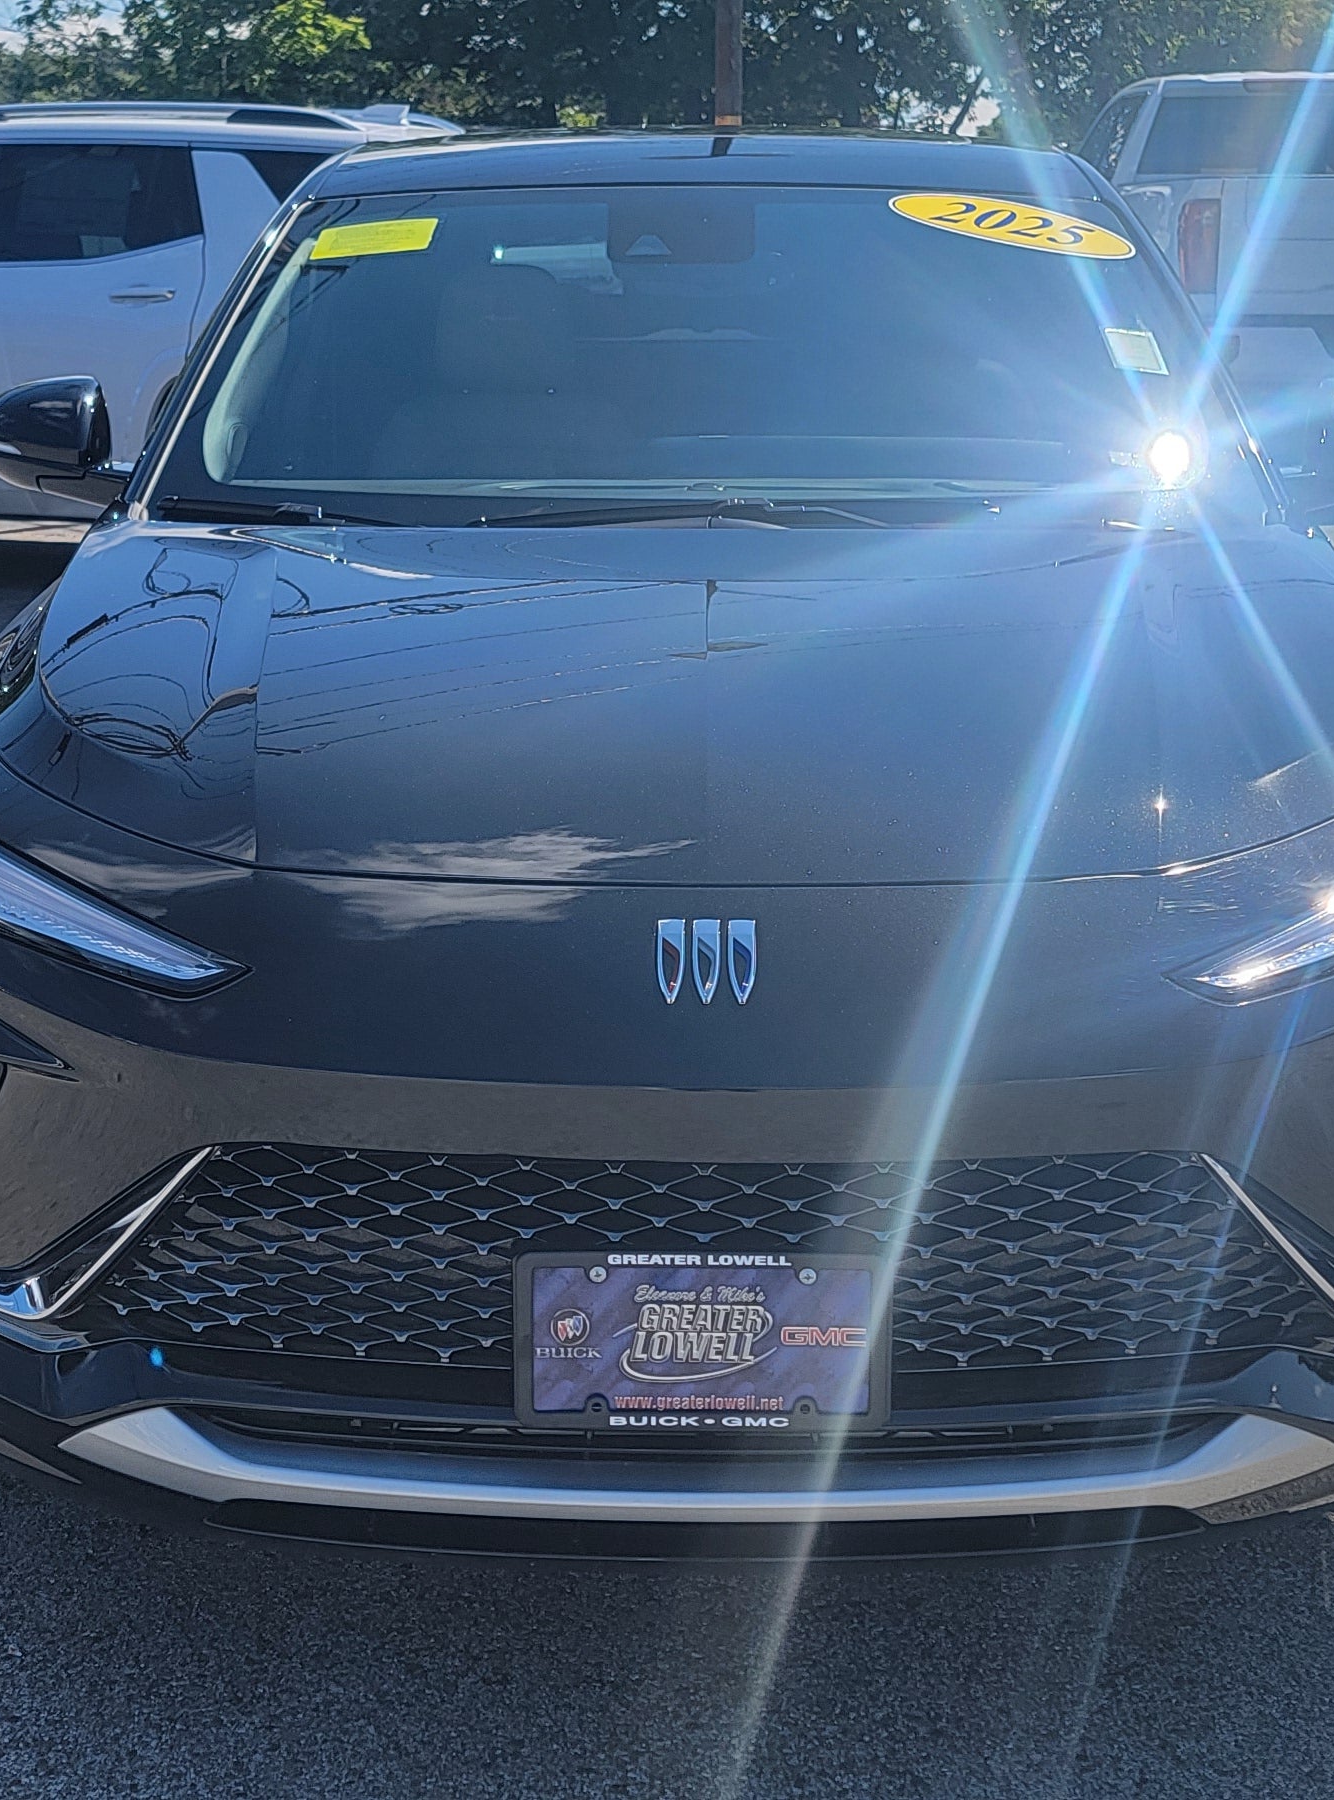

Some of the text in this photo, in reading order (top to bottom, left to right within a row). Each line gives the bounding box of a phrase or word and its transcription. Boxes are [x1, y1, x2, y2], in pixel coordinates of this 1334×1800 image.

[929, 202, 1095, 245] 2025
[607, 1254, 793, 1267] GREATER LOWELL
[717, 1285, 766, 1304] Mike's
[638, 1303, 766, 1333] GREATER
[781, 1327, 867, 1347] GMC
[534, 1346, 603, 1359] BUICK
[629, 1331, 756, 1364] LOWELL
[614, 1395, 785, 1412] www.greaterlowell.net
[609, 1415, 790, 1428] BUICK GMC
